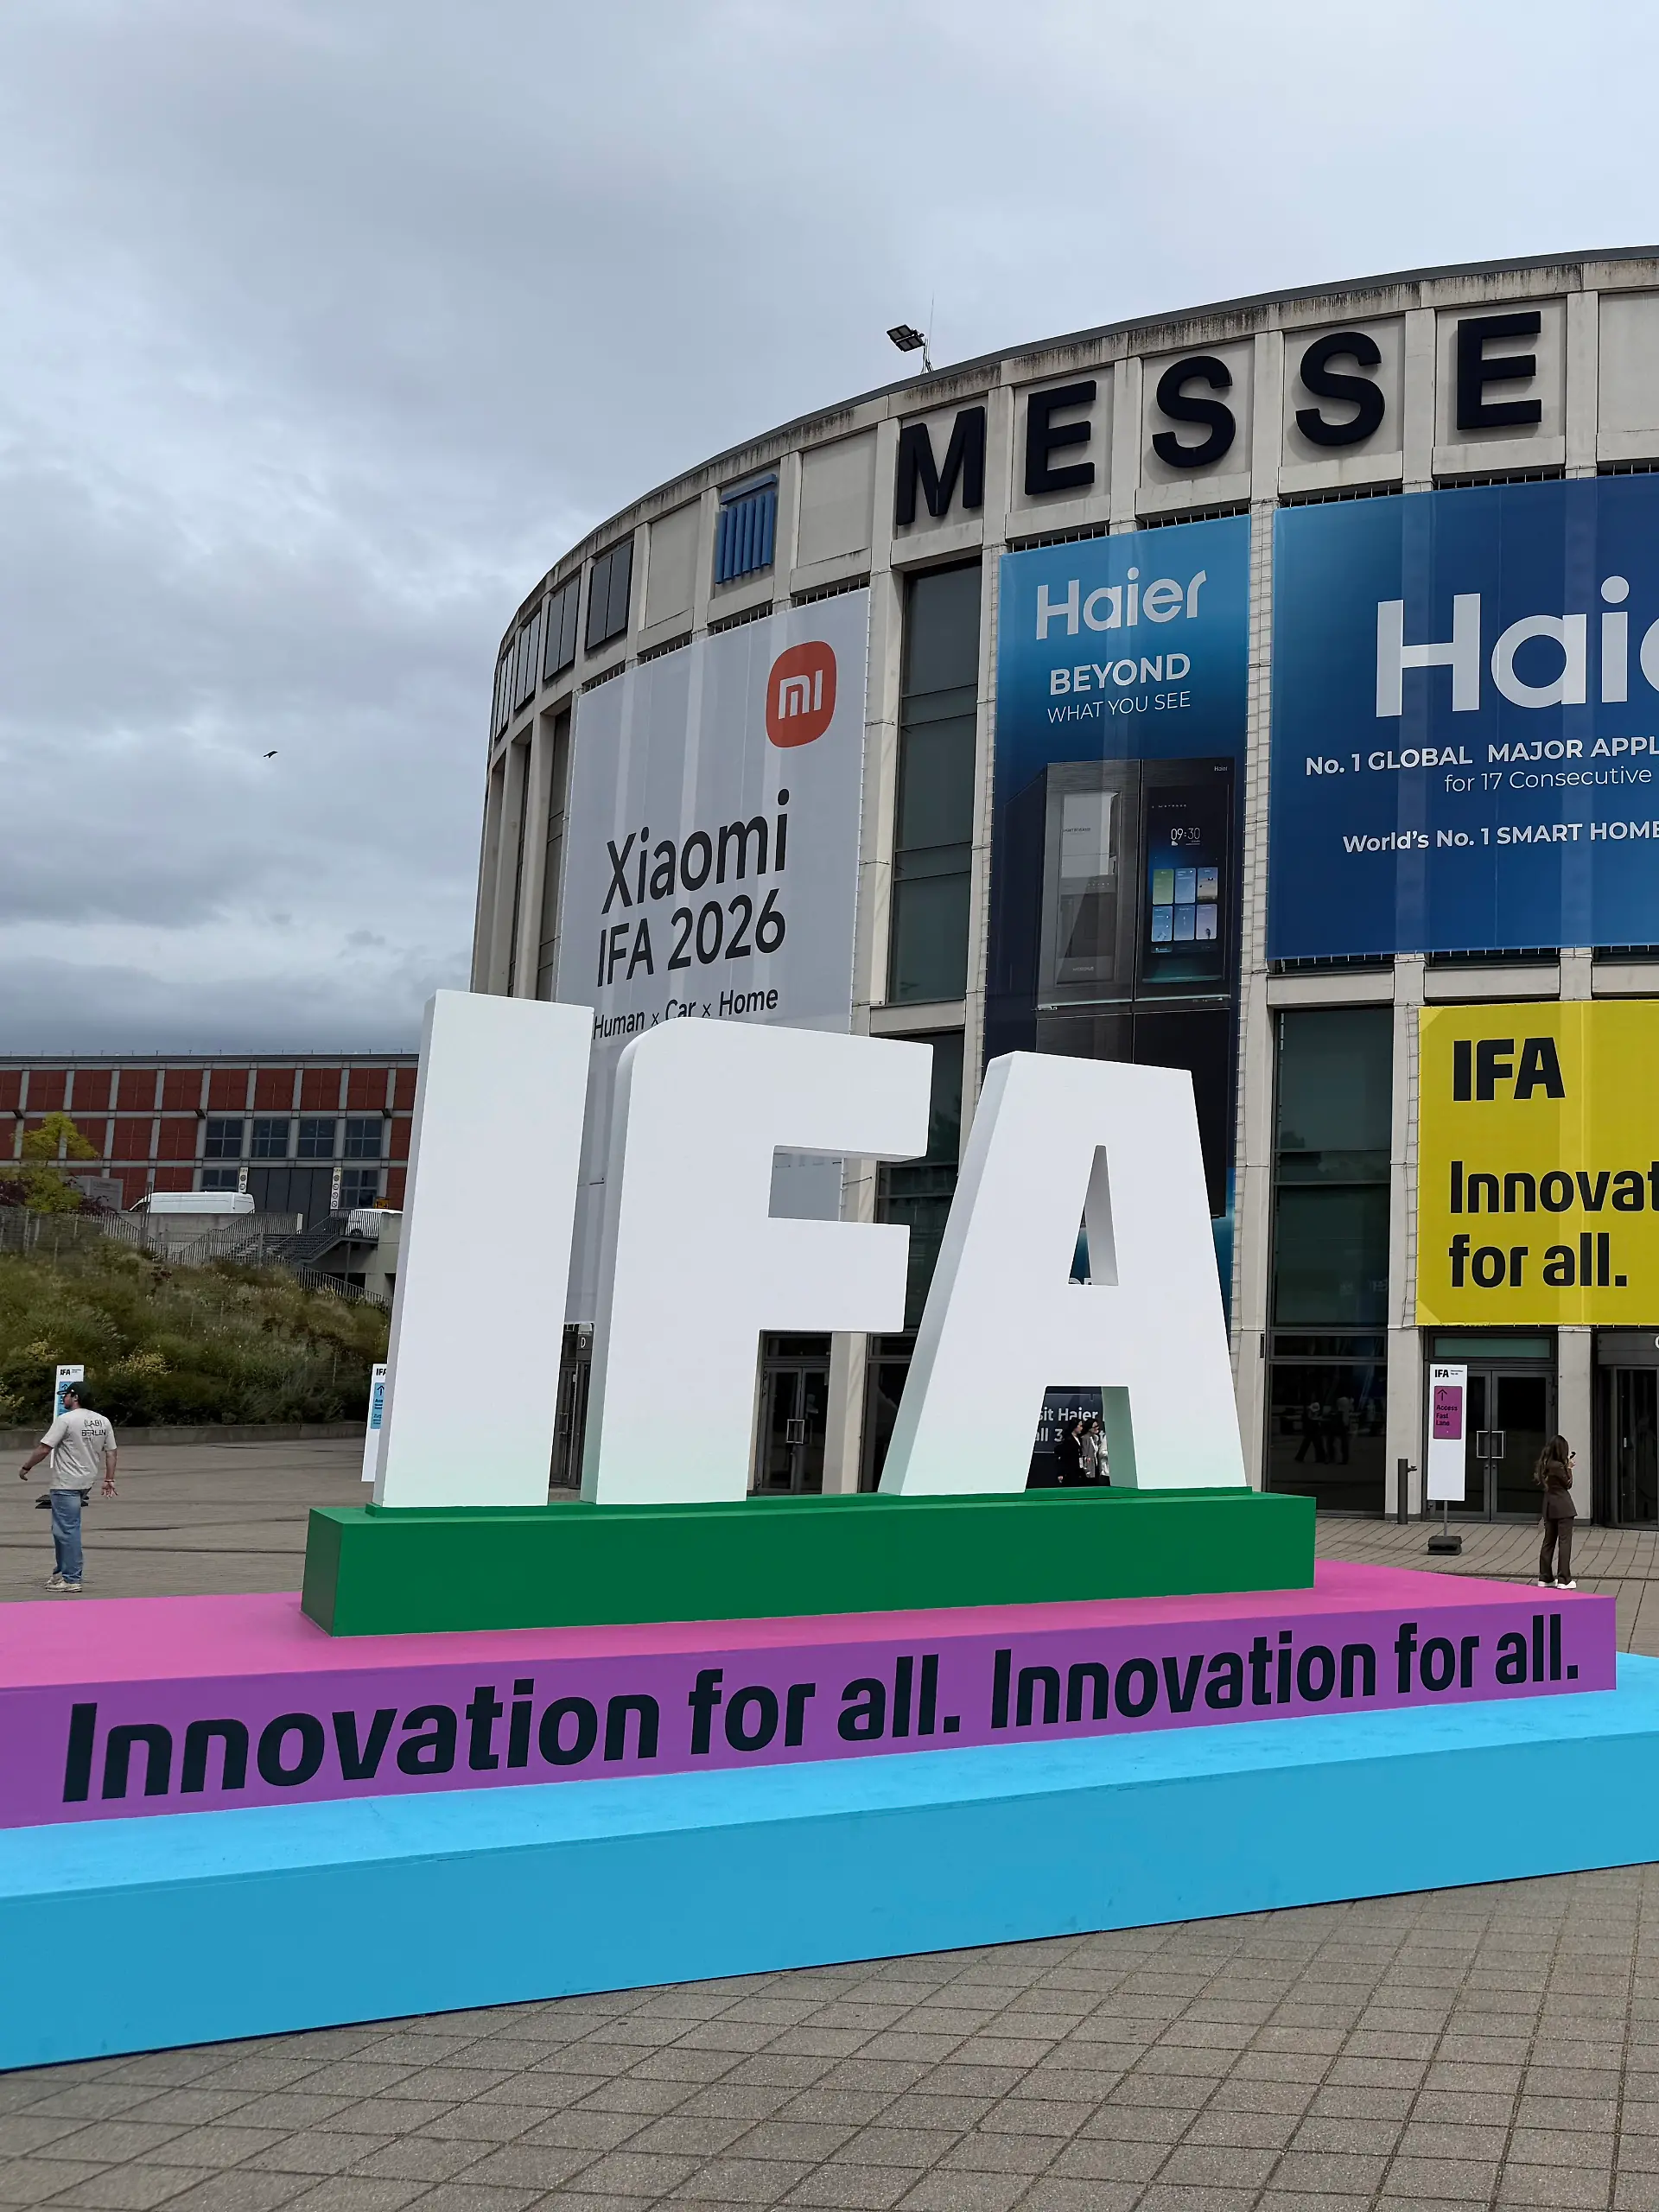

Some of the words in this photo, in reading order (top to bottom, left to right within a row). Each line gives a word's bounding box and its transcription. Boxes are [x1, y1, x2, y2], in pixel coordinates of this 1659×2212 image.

[895, 310, 1543, 525] MESSE
[1036, 567, 1207, 640] Haier
[1376, 575, 1659, 718] Hai
[1050, 652, 1191, 696] BEYOND
[1047, 701, 1104, 724] WHAT
[1108, 696, 1148, 715] YOU
[1154, 690, 1191, 711] SEE
[1306, 756, 1345, 776] No.
[1351, 753, 1361, 772] 1
[1368, 746, 1473, 772] GLOBAL
[1488, 739, 1583, 763] MAJOR
[1444, 774, 1476, 793] for
[1481, 772, 1503, 791] 17
[1510, 766, 1652, 790] Consecutive
[601, 788, 790, 915] Xiaomi
[1171, 827, 1201, 841] 09:30
[1343, 830, 1429, 853] World’s
[1437, 829, 1474, 848] No.
[1481, 827, 1489, 845] 1
[1497, 823, 1583, 845] SMART
[597, 918, 655, 988] IFA
[667, 887, 786, 971] 2026
[593, 1011, 645, 1040] Human
[665, 999, 696, 1020] Car
[719, 988, 779, 1017] Home
[1452, 1037, 1566, 1102] IFA
[374, 988, 1251, 1509] IFA
[1449, 1234, 1529, 1287] for
[1542, 1232, 1628, 1287] all.
[1434, 1369, 1449, 1377] IFA
[1058, 1407, 1098, 1421] Haier
[62, 1677, 659, 1802] Innovation
[687, 1668, 817, 1755] for
[837, 1654, 962, 1742] all.
[990, 1630, 1376, 1729] Innovation
[1394, 1622, 1480, 1694] for
[1495, 1613, 1579, 1685] all.
